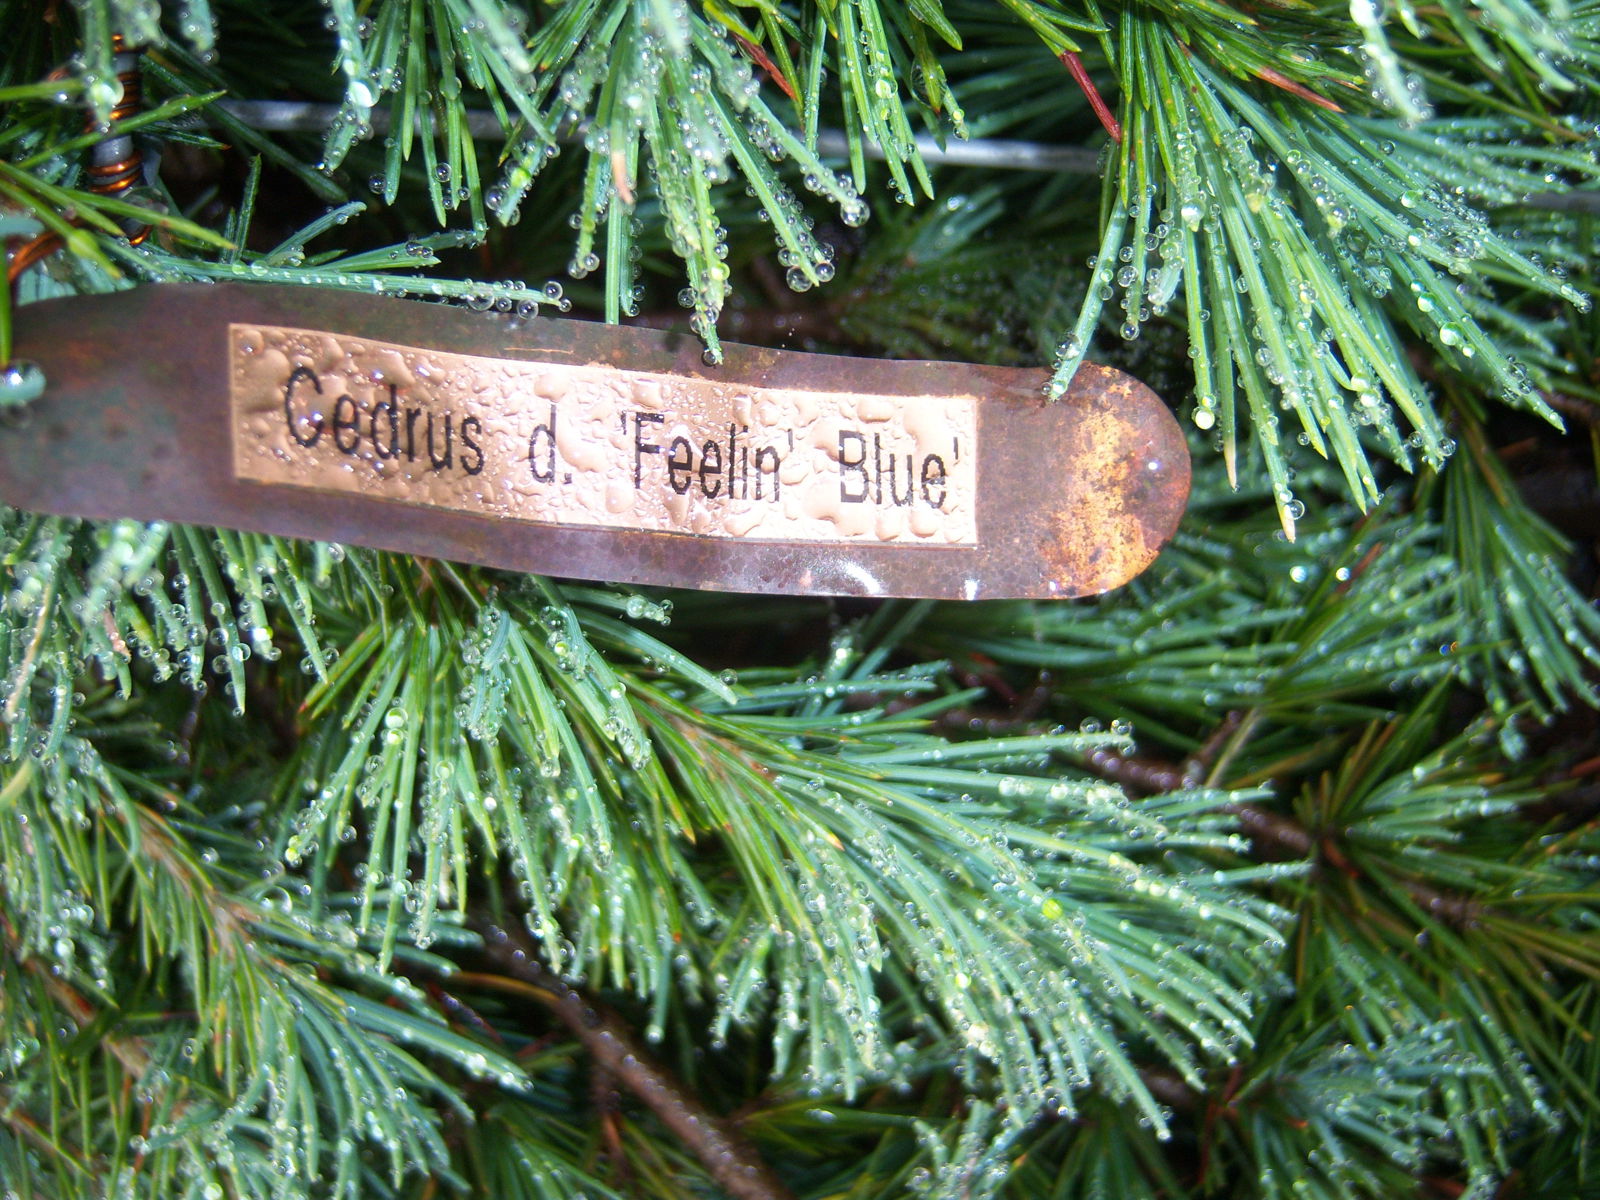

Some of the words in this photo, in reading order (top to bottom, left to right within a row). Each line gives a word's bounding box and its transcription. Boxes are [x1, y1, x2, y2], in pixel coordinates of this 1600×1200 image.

[284, 367, 485, 475] Cedrus
[528, 401, 573, 484] d.
[620, 410, 794, 502] 'Feelin'
[838, 429, 959, 509] Blue'
